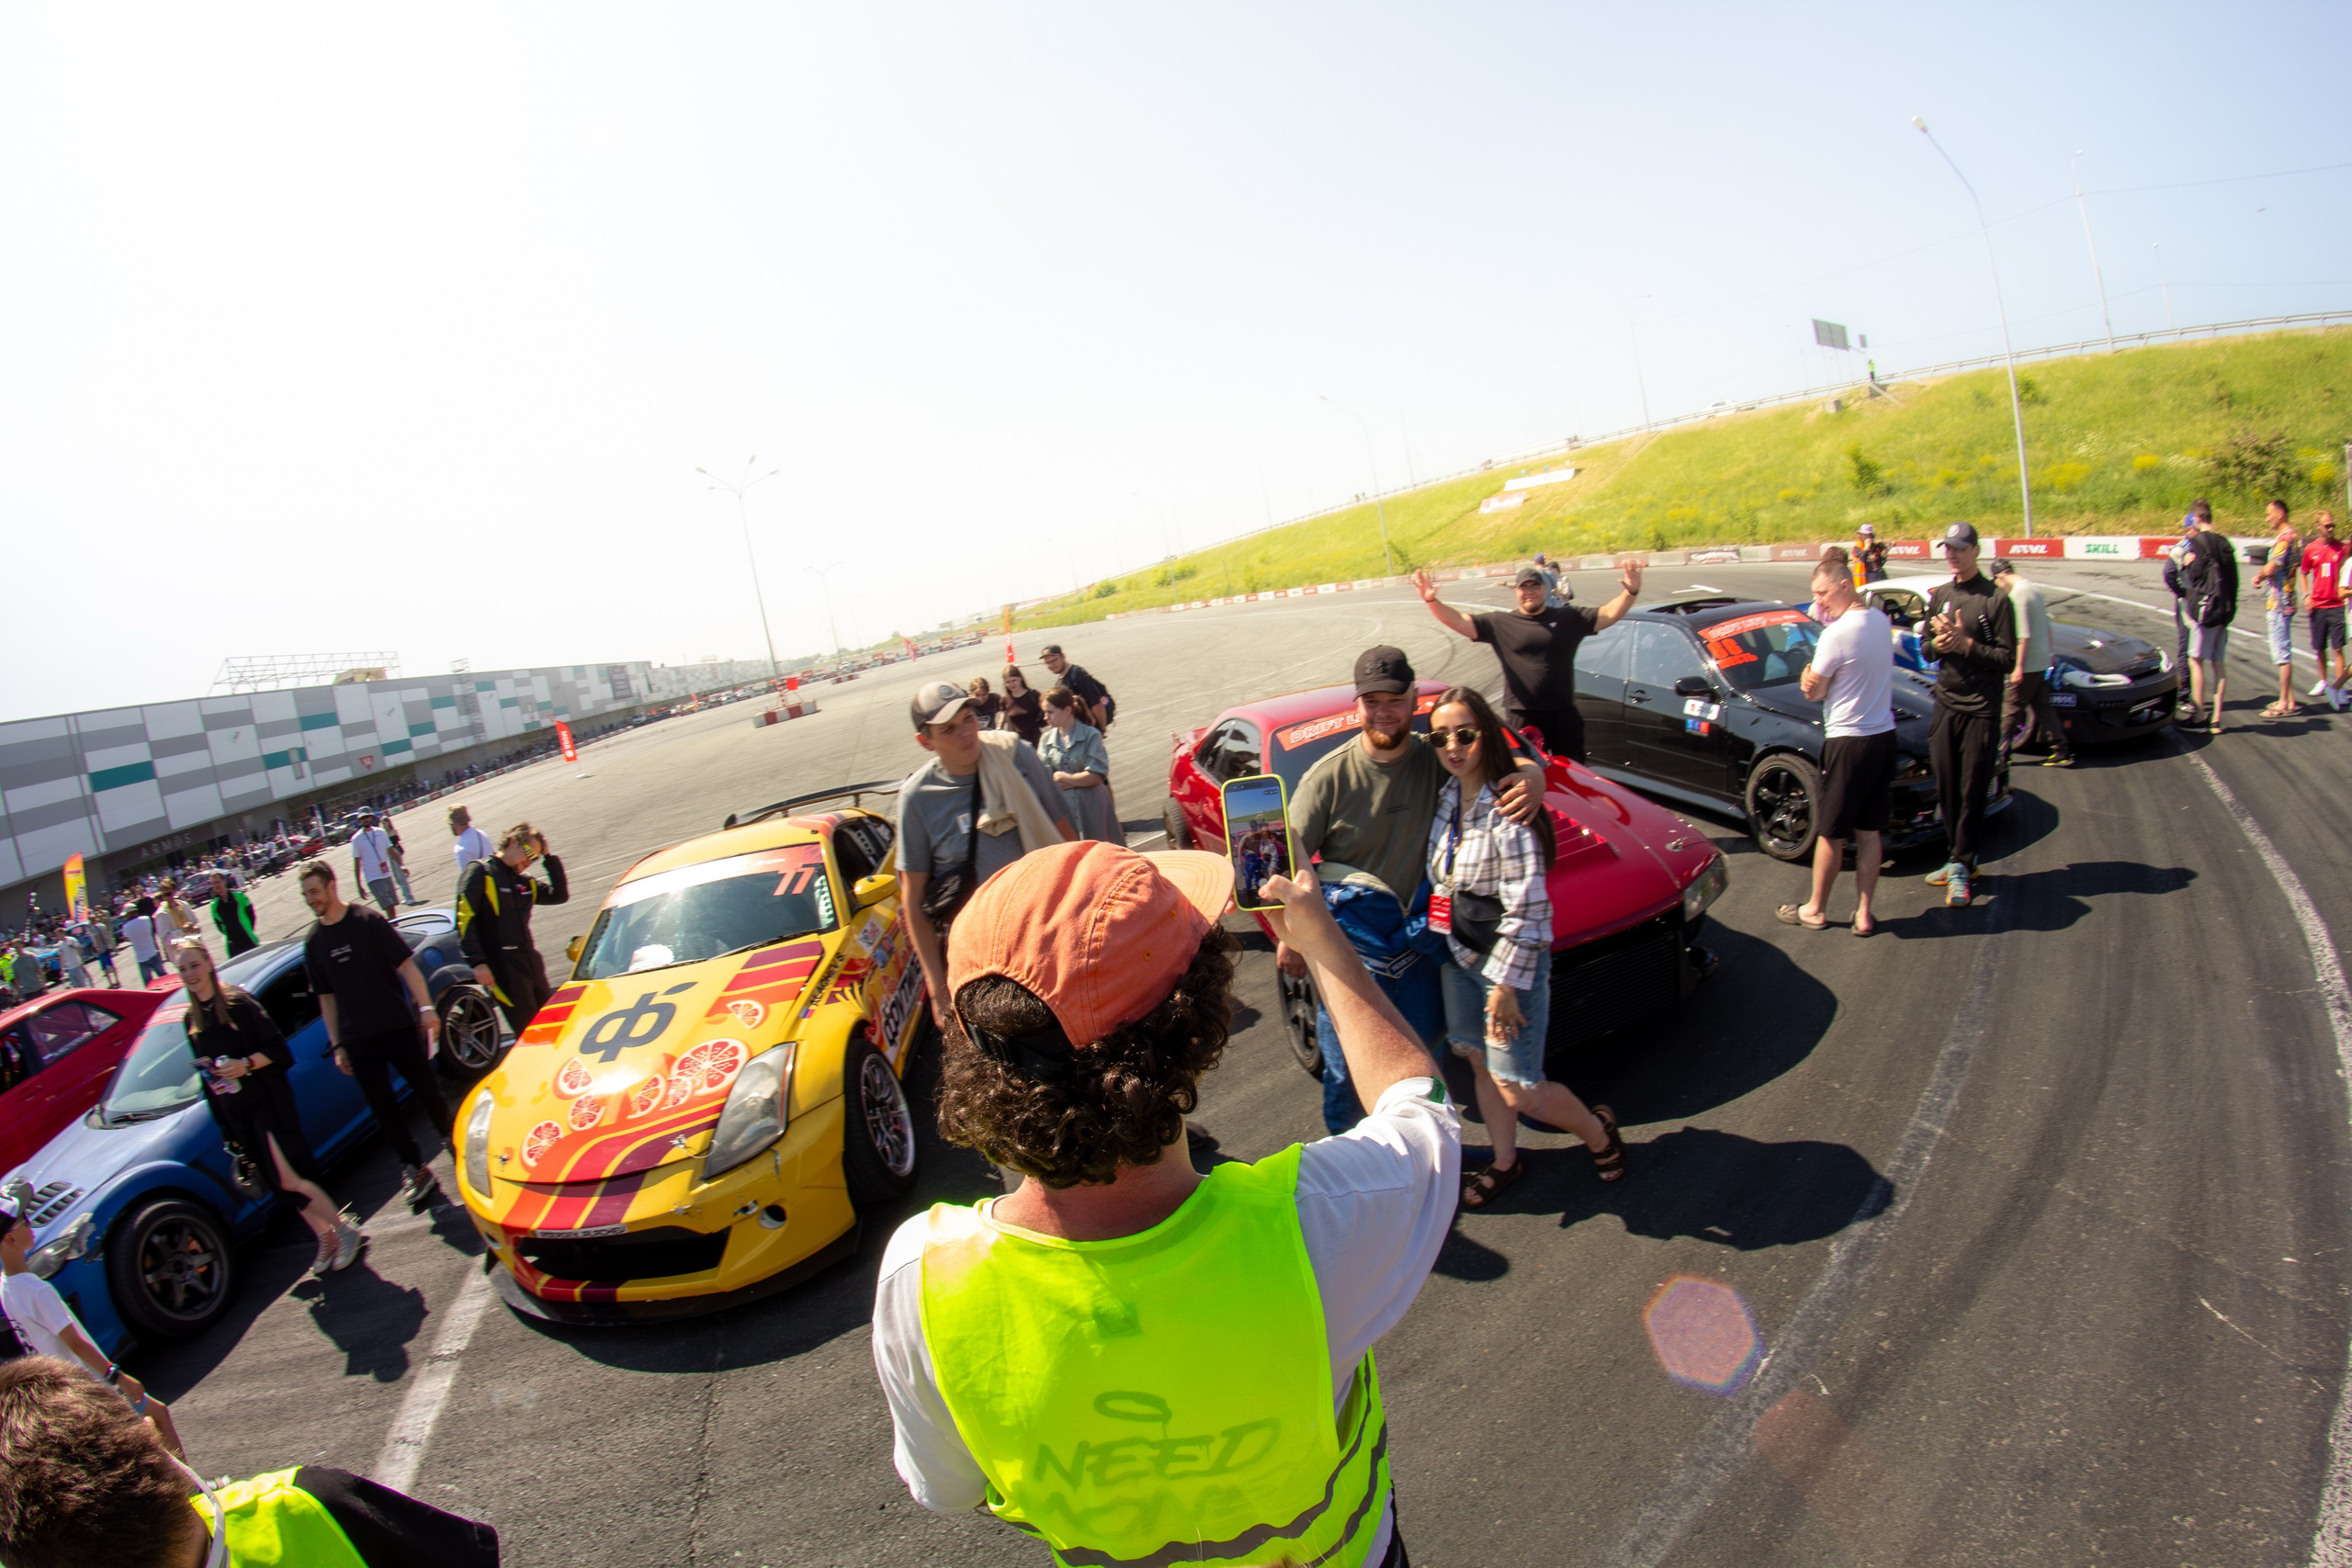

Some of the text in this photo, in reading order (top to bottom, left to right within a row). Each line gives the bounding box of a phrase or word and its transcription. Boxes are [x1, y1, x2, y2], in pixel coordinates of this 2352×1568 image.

[2084, 543, 2119, 554] SKILL
[1289, 716, 1345, 745] DRIFT
[773, 866, 816, 897] 77
[1034, 1416, 1281, 1492] NEED
